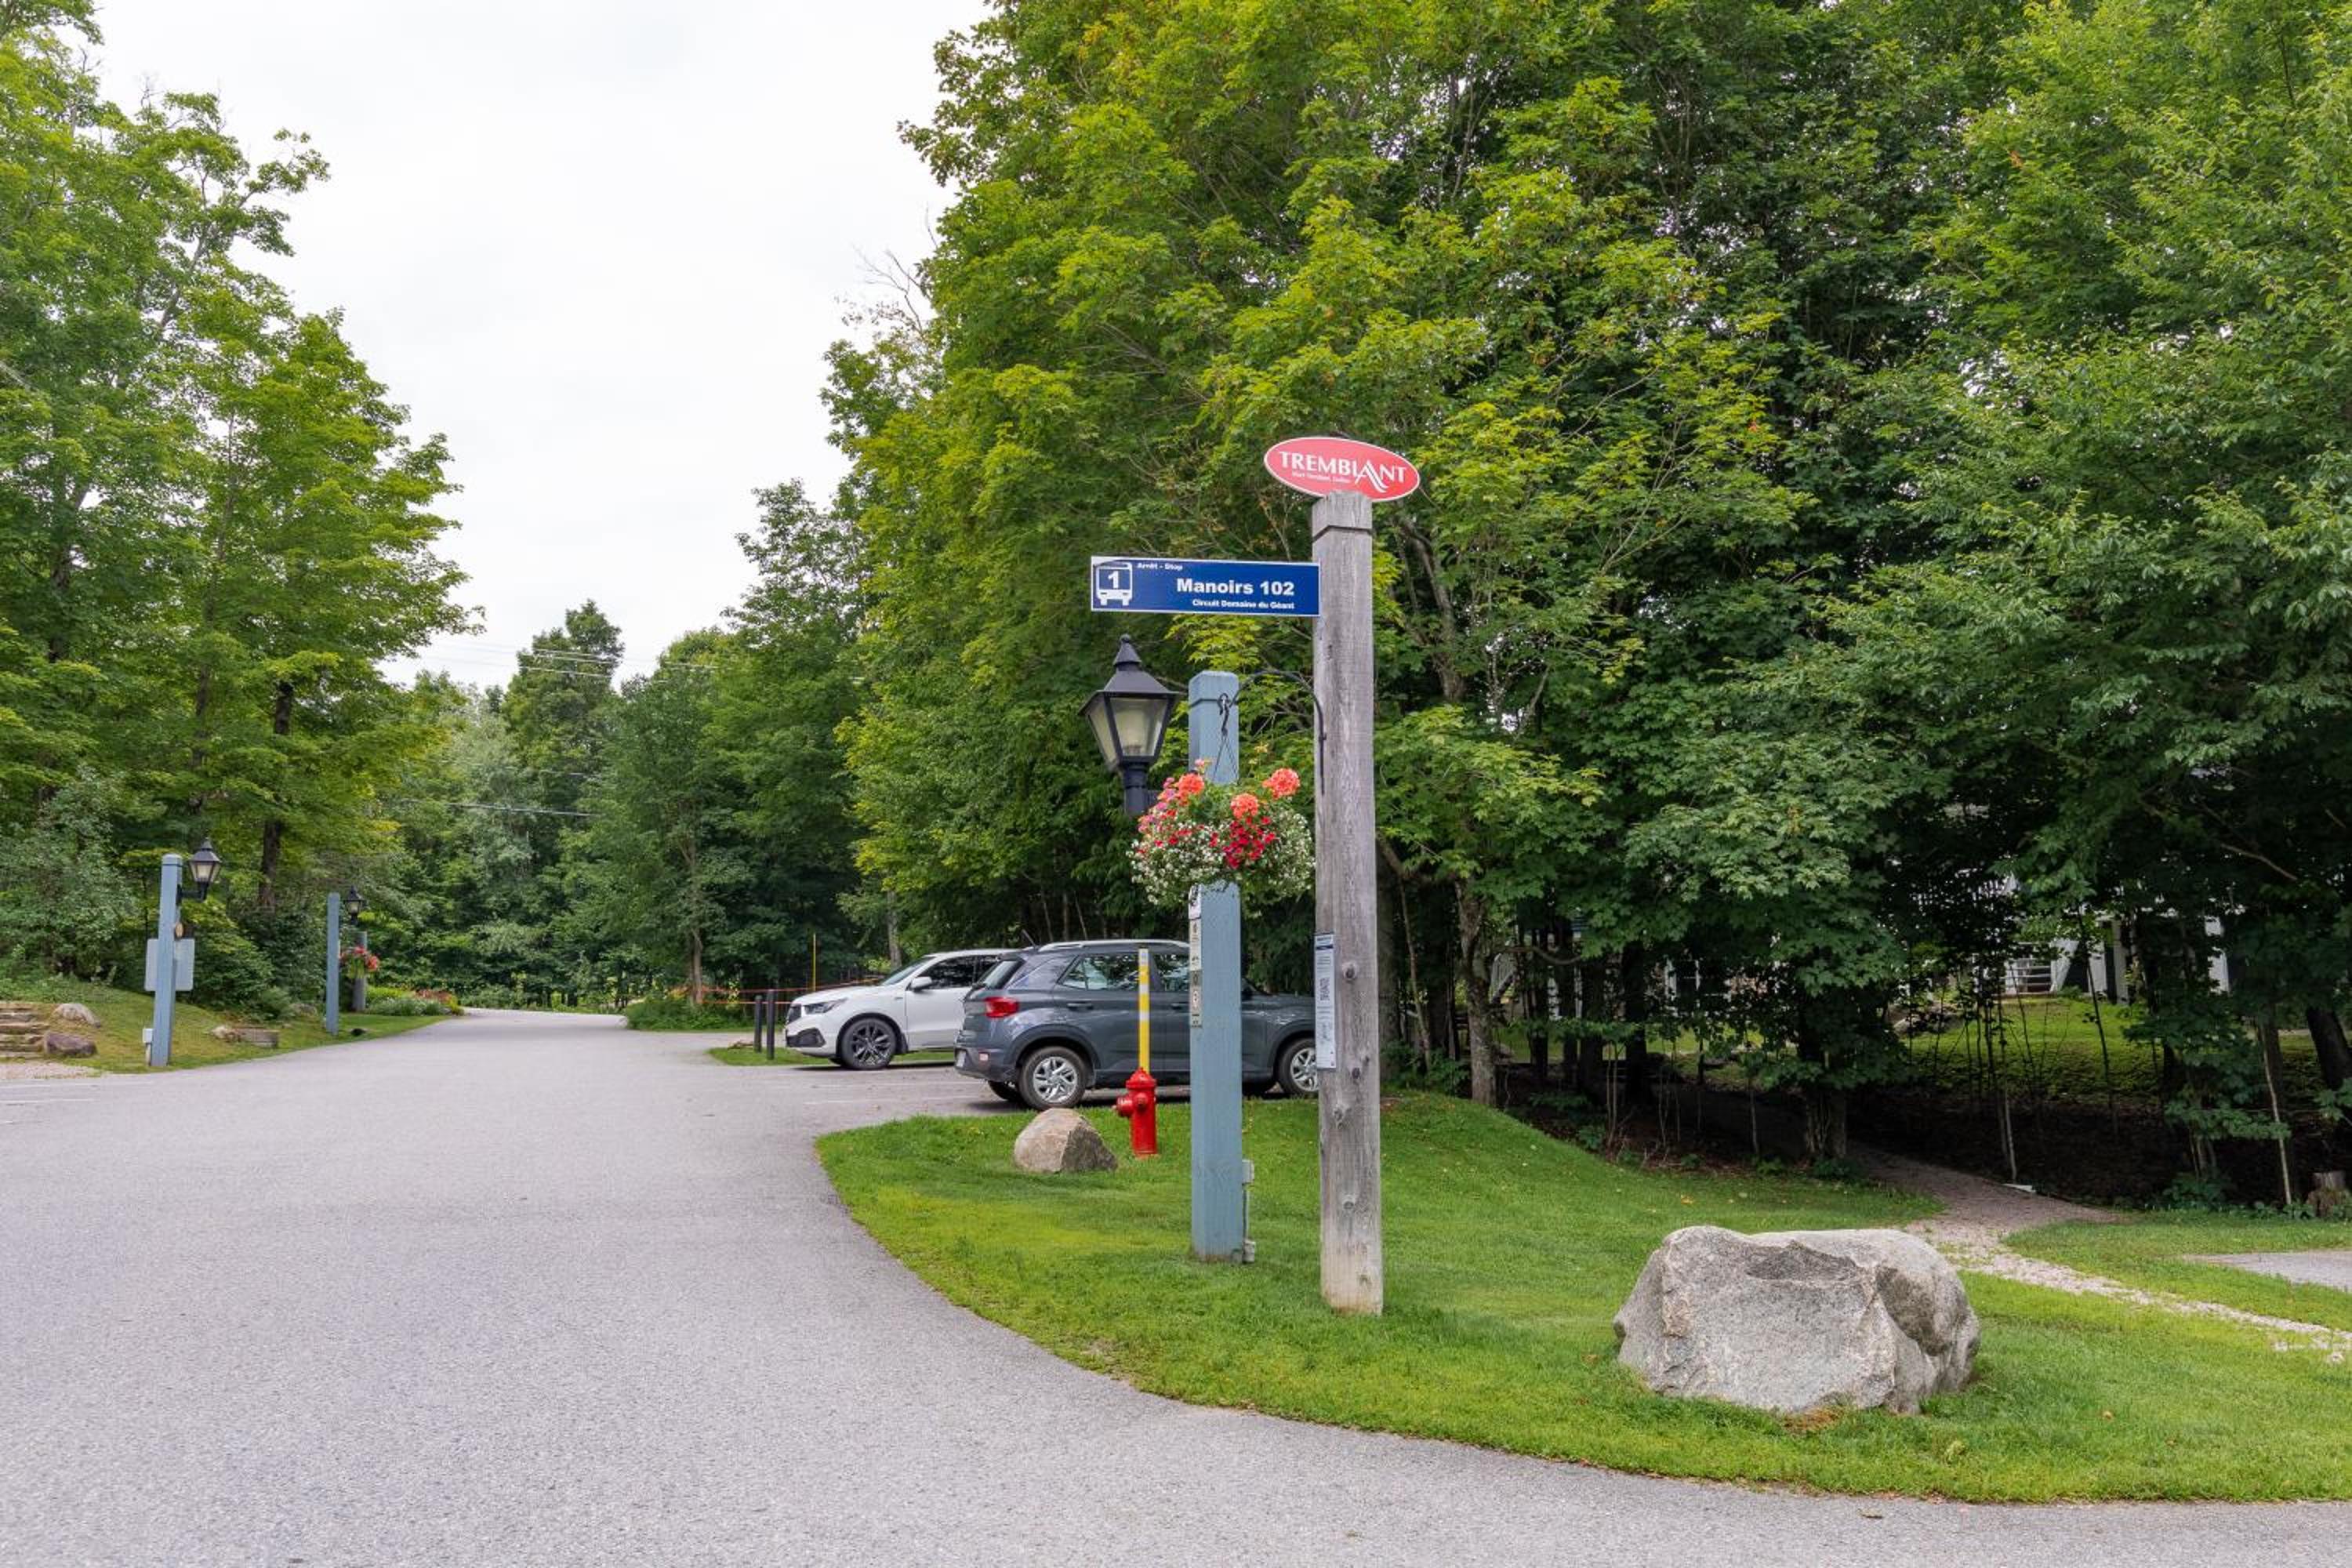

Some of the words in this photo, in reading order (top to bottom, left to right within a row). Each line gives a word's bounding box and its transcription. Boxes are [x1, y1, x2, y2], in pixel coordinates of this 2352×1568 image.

[1279, 451, 1407, 492] TREMBLANT
[1108, 571, 1119, 588] 1
[1177, 578, 1254, 594] Manoirs
[1260, 581, 1294, 596] 102
[1192, 598, 1220, 607] Circuit
